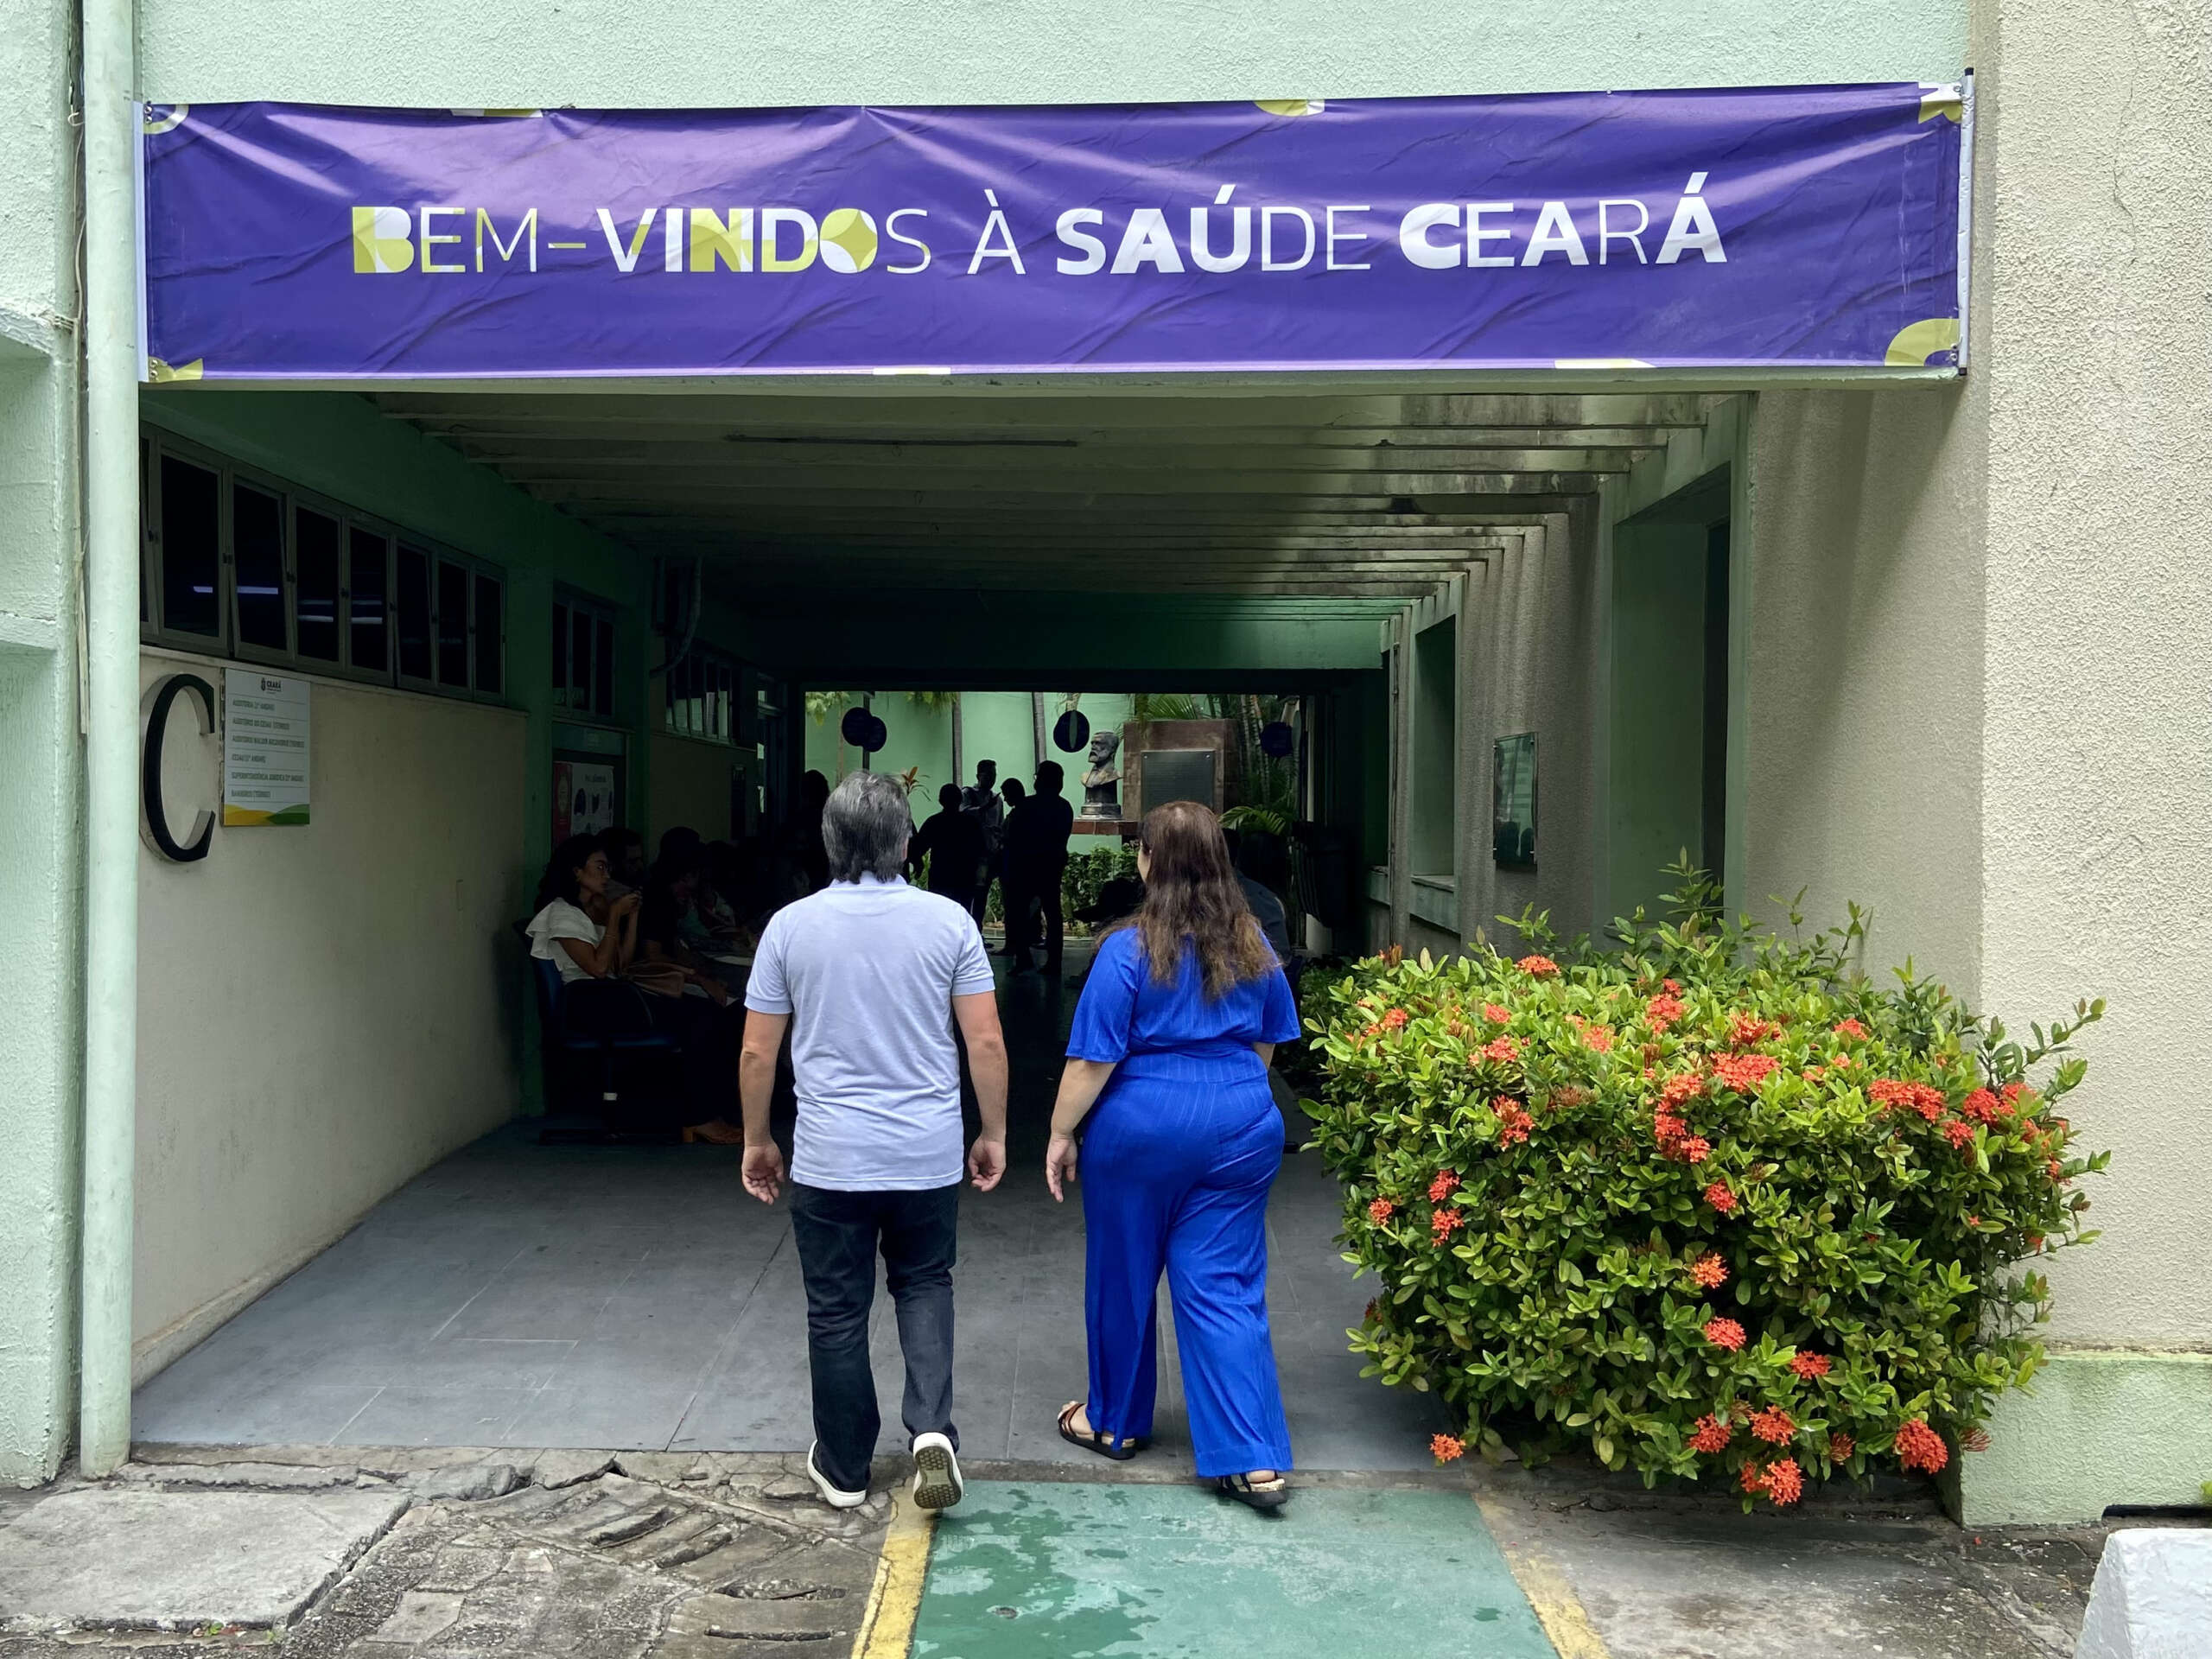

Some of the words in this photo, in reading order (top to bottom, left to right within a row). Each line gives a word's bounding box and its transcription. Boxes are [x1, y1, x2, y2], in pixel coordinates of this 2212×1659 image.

[351, 206, 932, 274] BEM-VINDOS
[966, 188, 1027, 276] À
[1054, 183, 1372, 274] SAÚDE
[1398, 171, 1728, 270] CEARÁ
[142, 673, 216, 862] C
